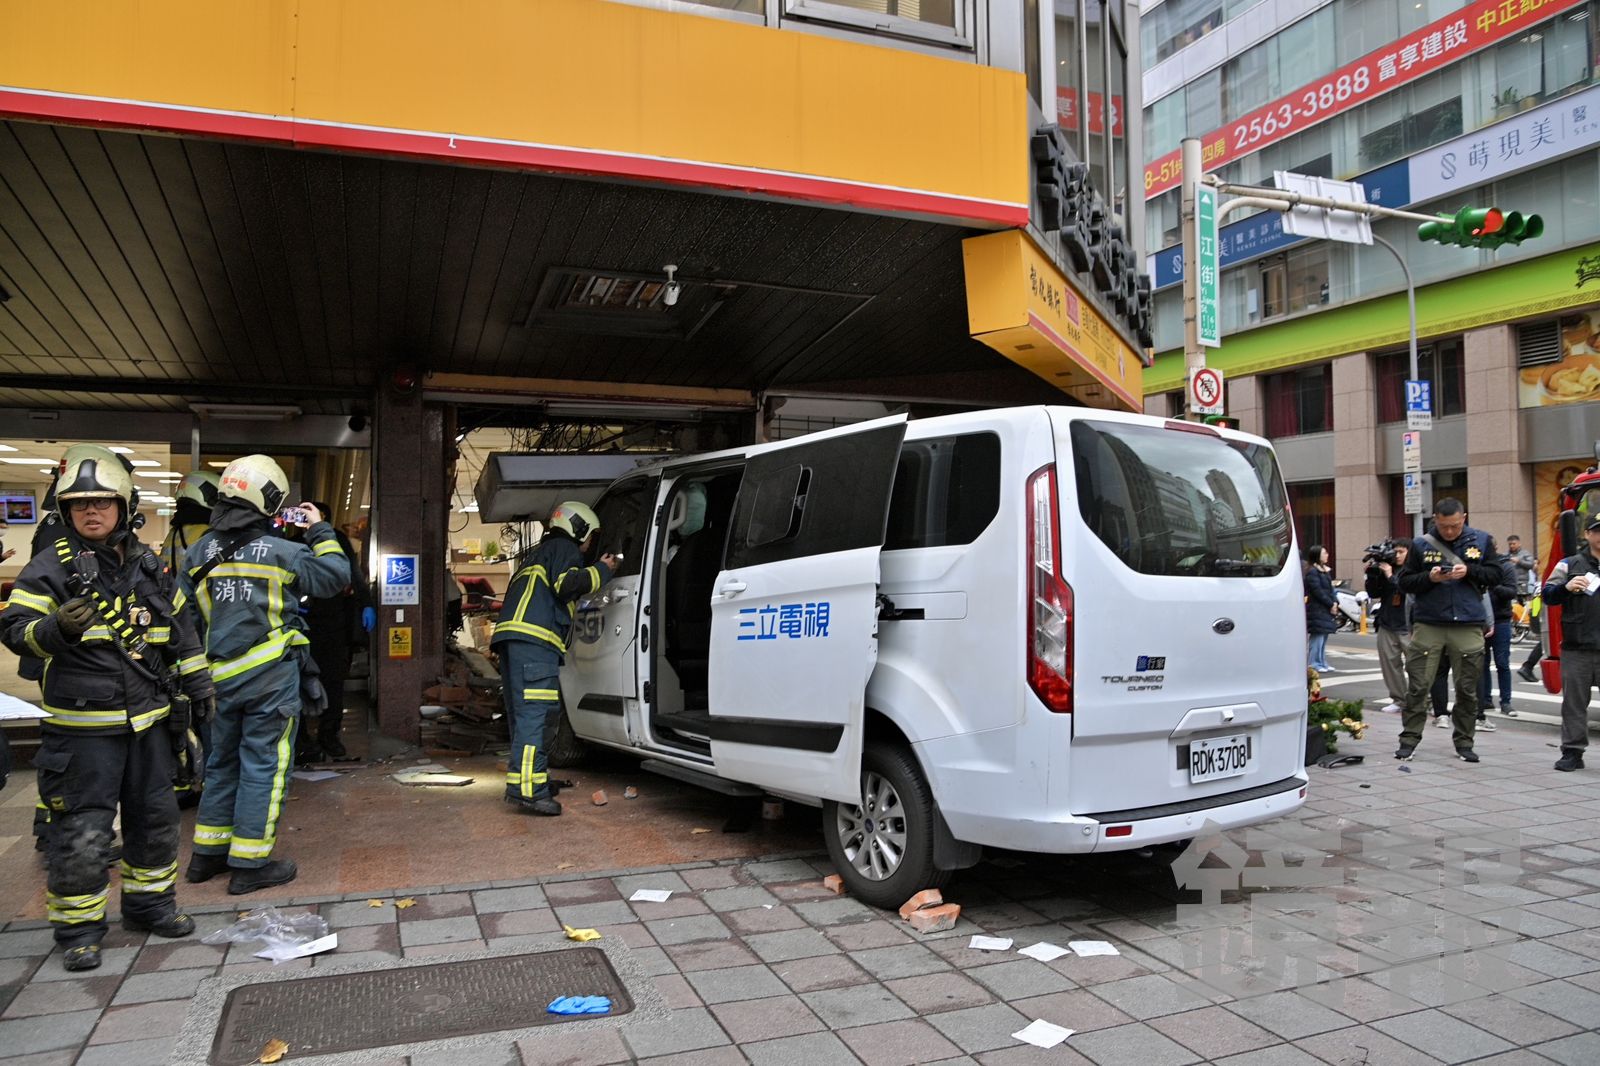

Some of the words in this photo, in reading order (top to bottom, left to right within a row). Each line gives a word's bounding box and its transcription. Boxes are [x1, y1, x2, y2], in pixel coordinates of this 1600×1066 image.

[1202, 138, 1225, 163] 四房
[1234, 66, 1370, 150] 2563-3888
[1377, 18, 1468, 82] 富享建設
[1469, 117, 1555, 172] 蒔現美
[1201, 214, 1214, 286] 一江街
[215, 578, 254, 602] 消防
[737, 602, 830, 640] 三立電視
[1101, 675, 1164, 684] TOURNEO
